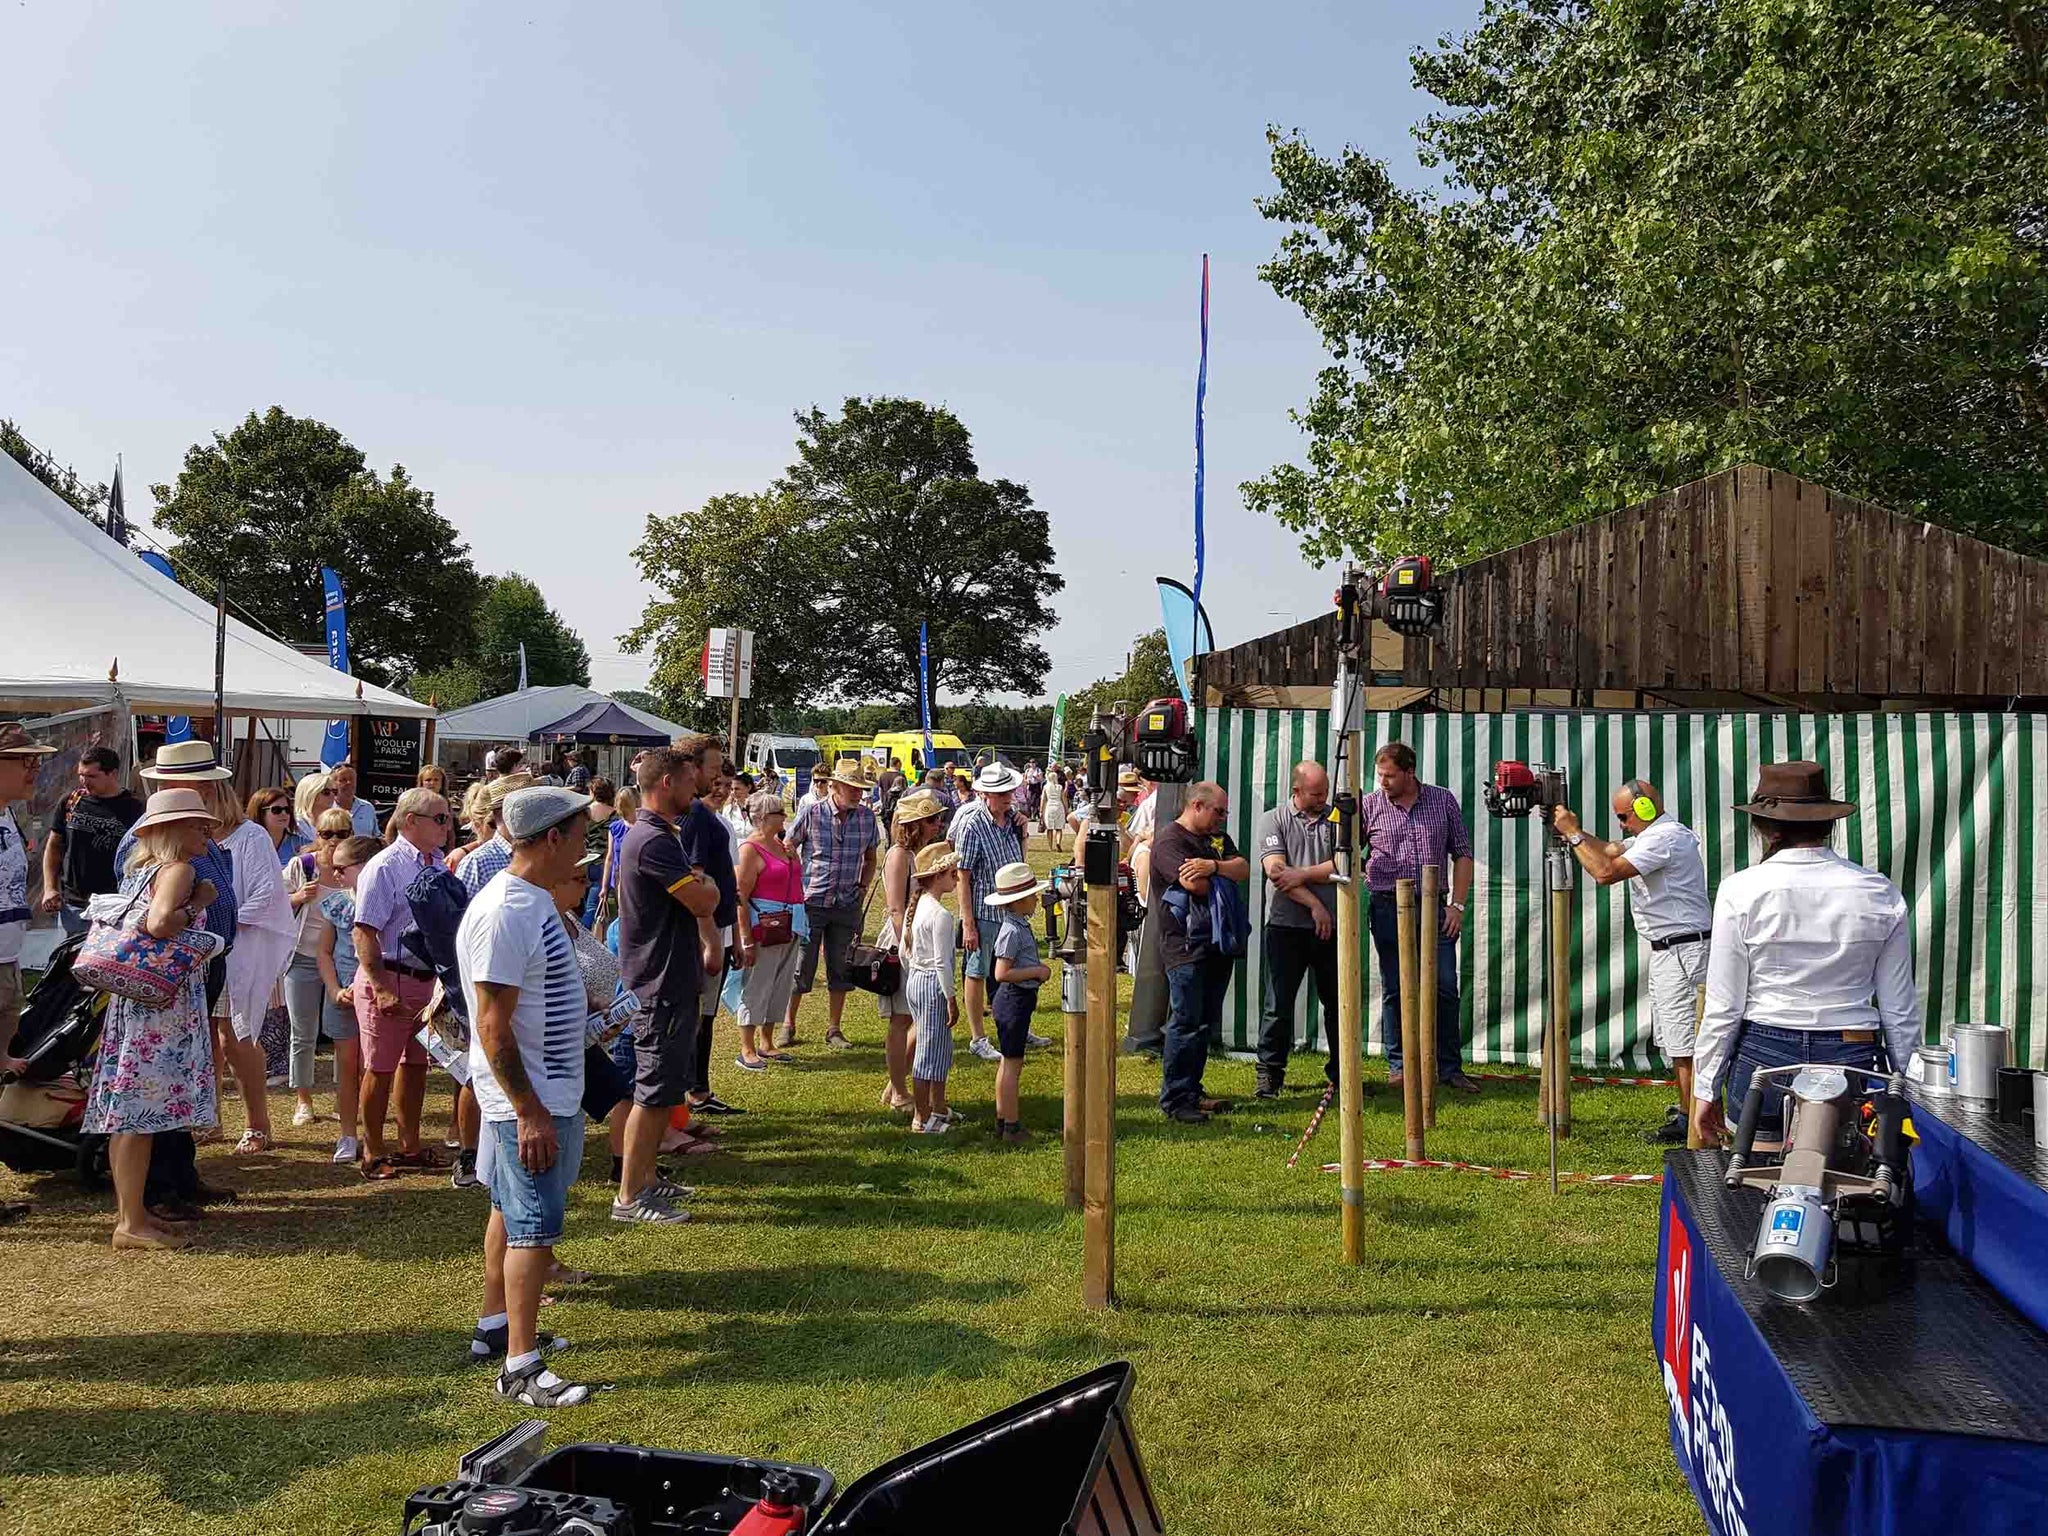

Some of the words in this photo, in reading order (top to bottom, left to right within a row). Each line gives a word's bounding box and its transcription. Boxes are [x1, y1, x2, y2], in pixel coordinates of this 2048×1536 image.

[373, 739, 417, 749] WOOLLEY
[380, 746, 408, 756] PARKS
[373, 785, 391, 794] FOR
[392, 786, 408, 795] SAL
[1266, 835, 1279, 846] 08
